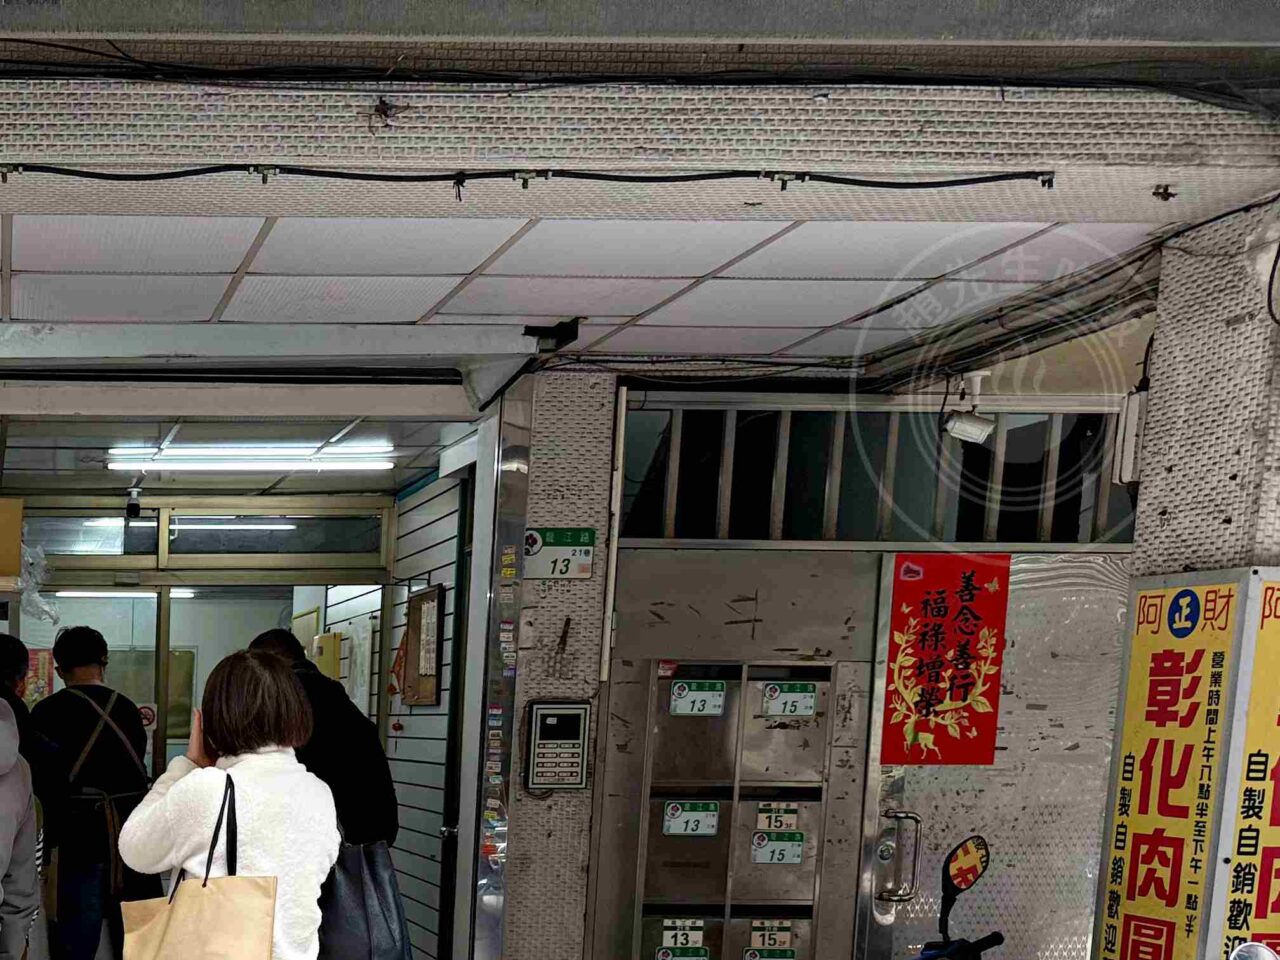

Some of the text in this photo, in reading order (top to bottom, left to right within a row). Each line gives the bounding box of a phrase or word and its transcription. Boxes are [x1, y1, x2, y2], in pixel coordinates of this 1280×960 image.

[550, 558, 571, 575] 13
[949, 570, 983, 703] 善念善行
[689, 699, 707, 712] 13
[781, 700, 799, 713] 15
[1185, 650, 1226, 938] 營業時間上午八點半至下午一點半
[683, 819, 701, 832] 13
[765, 814, 783, 829] 15
[769, 849, 786, 862] 15
[671, 932, 689, 946] 13
[759, 933, 777, 946] 15
